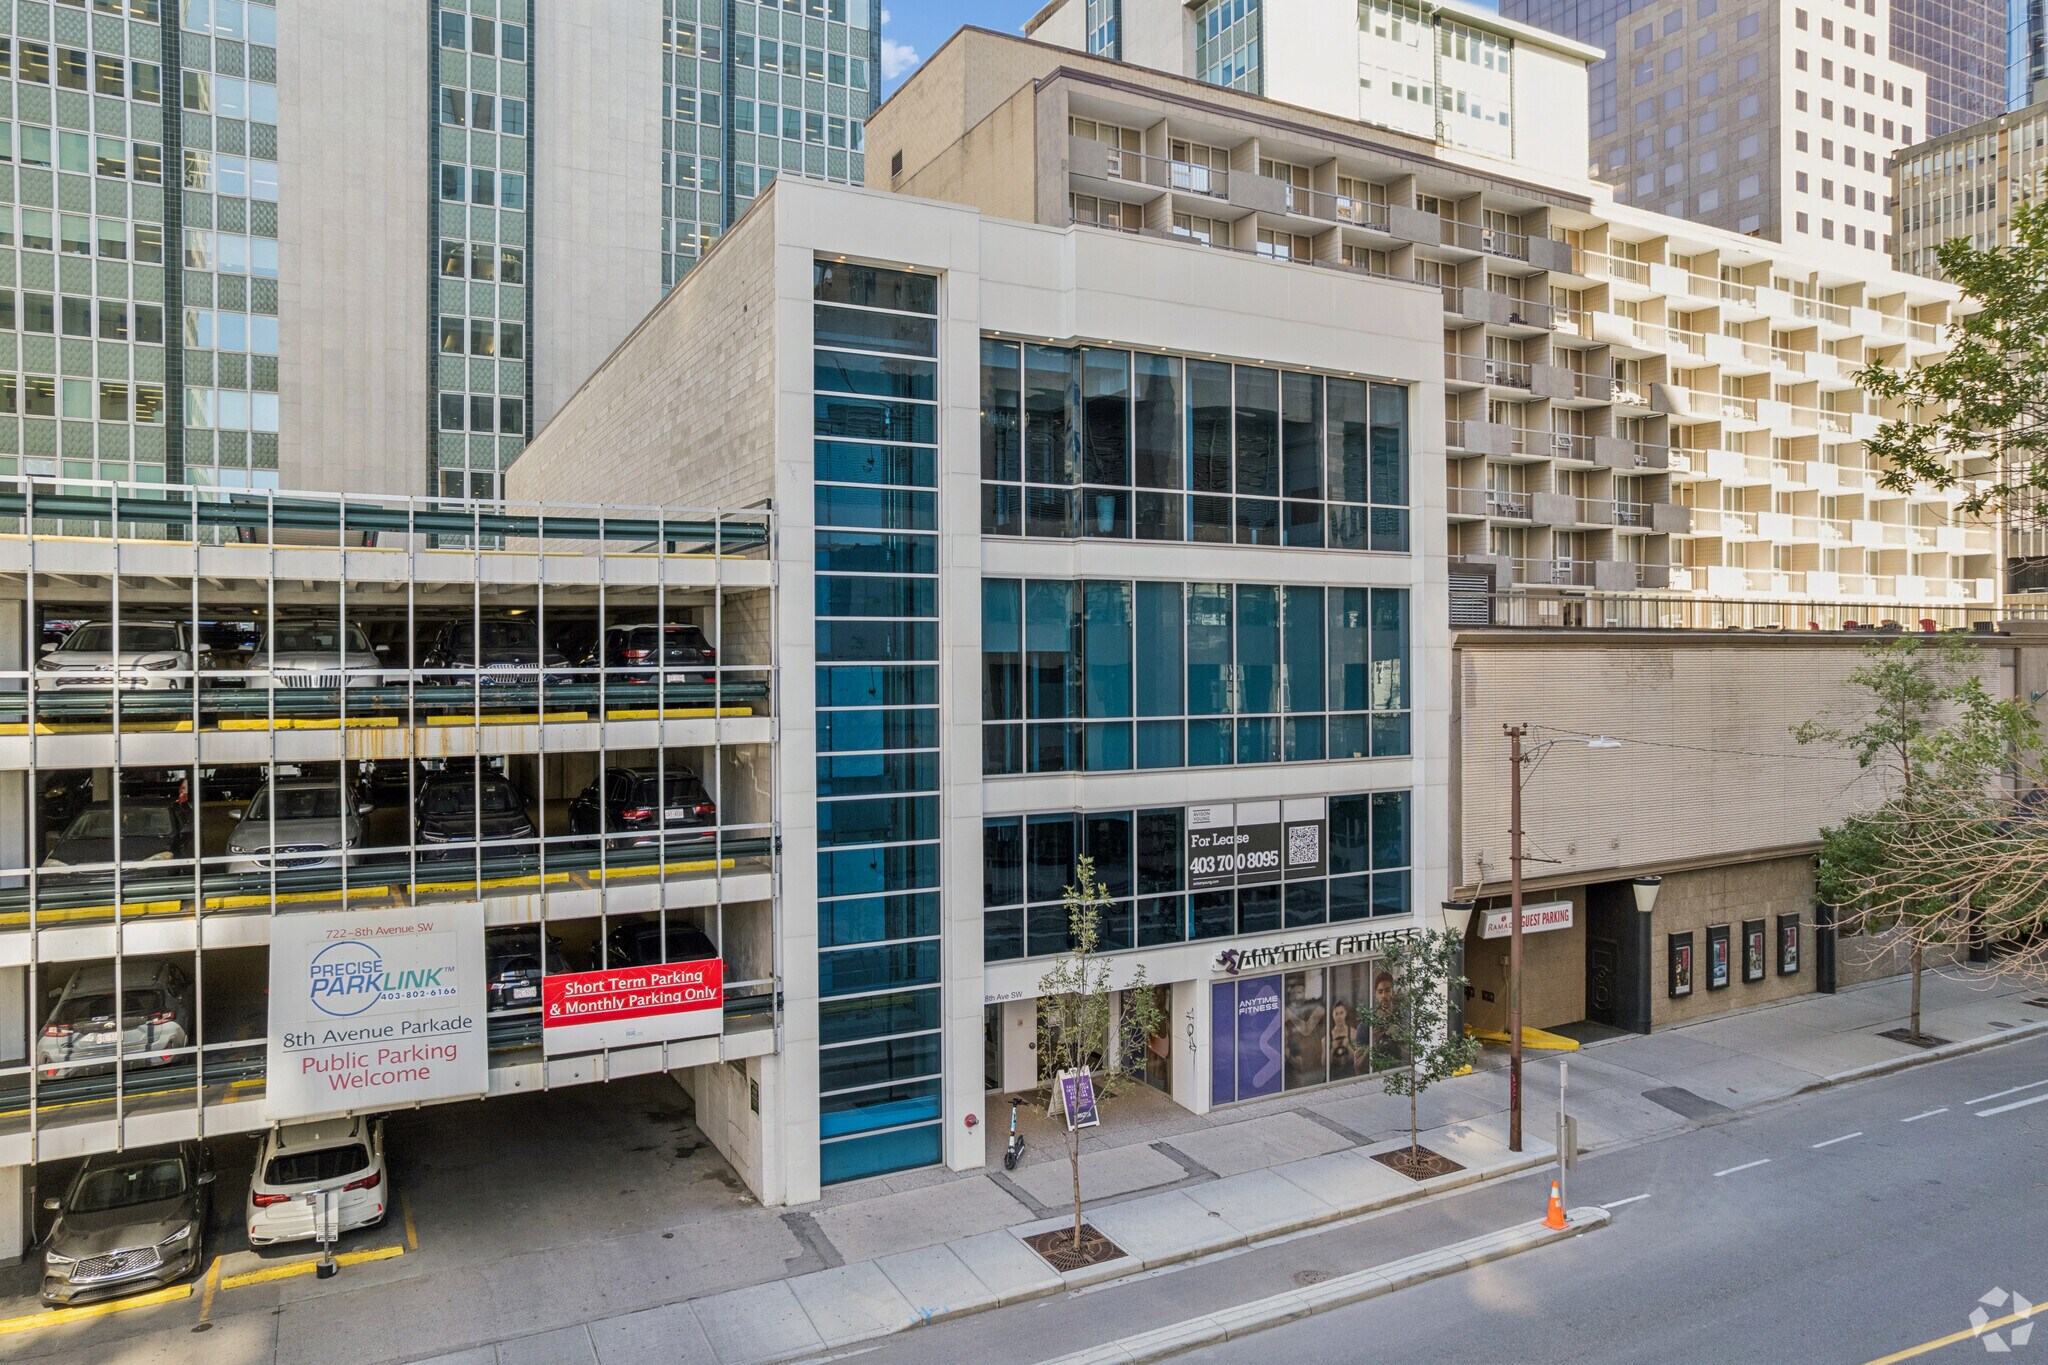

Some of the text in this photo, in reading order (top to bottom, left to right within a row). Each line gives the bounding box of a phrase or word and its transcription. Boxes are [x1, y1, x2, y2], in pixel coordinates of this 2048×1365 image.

[1191, 833, 1250, 848] For Lease
[1190, 850, 1279, 874] 403 700 8095
[1487, 921, 1512, 931] RAMAD
[1520, 909, 1569, 928] GUEST PARKING
[375, 925, 414, 936] Avenue
[417, 922, 434, 933] SW
[1237, 927, 1421, 970] ANYTIME FITNESS
[310, 960, 383, 978] PRECISE
[310, 967, 443, 998] PARKLINK
[565, 971, 703, 995] Short Term Parking
[381, 987, 457, 1000] 403-802-6166
[550, 986, 717, 1016] & Monthly Parking Only
[996, 993, 1010, 1001] Ave
[1010, 991, 1023, 999] SW
[1239, 995, 1278, 1008] ANYTIME
[1239, 1002, 1278, 1015] FITNESS
[283, 1015, 473, 1048] 8th Avenue Parkade
[302, 1043, 457, 1074] Public Parking
[328, 1066, 431, 1091] Welcome
